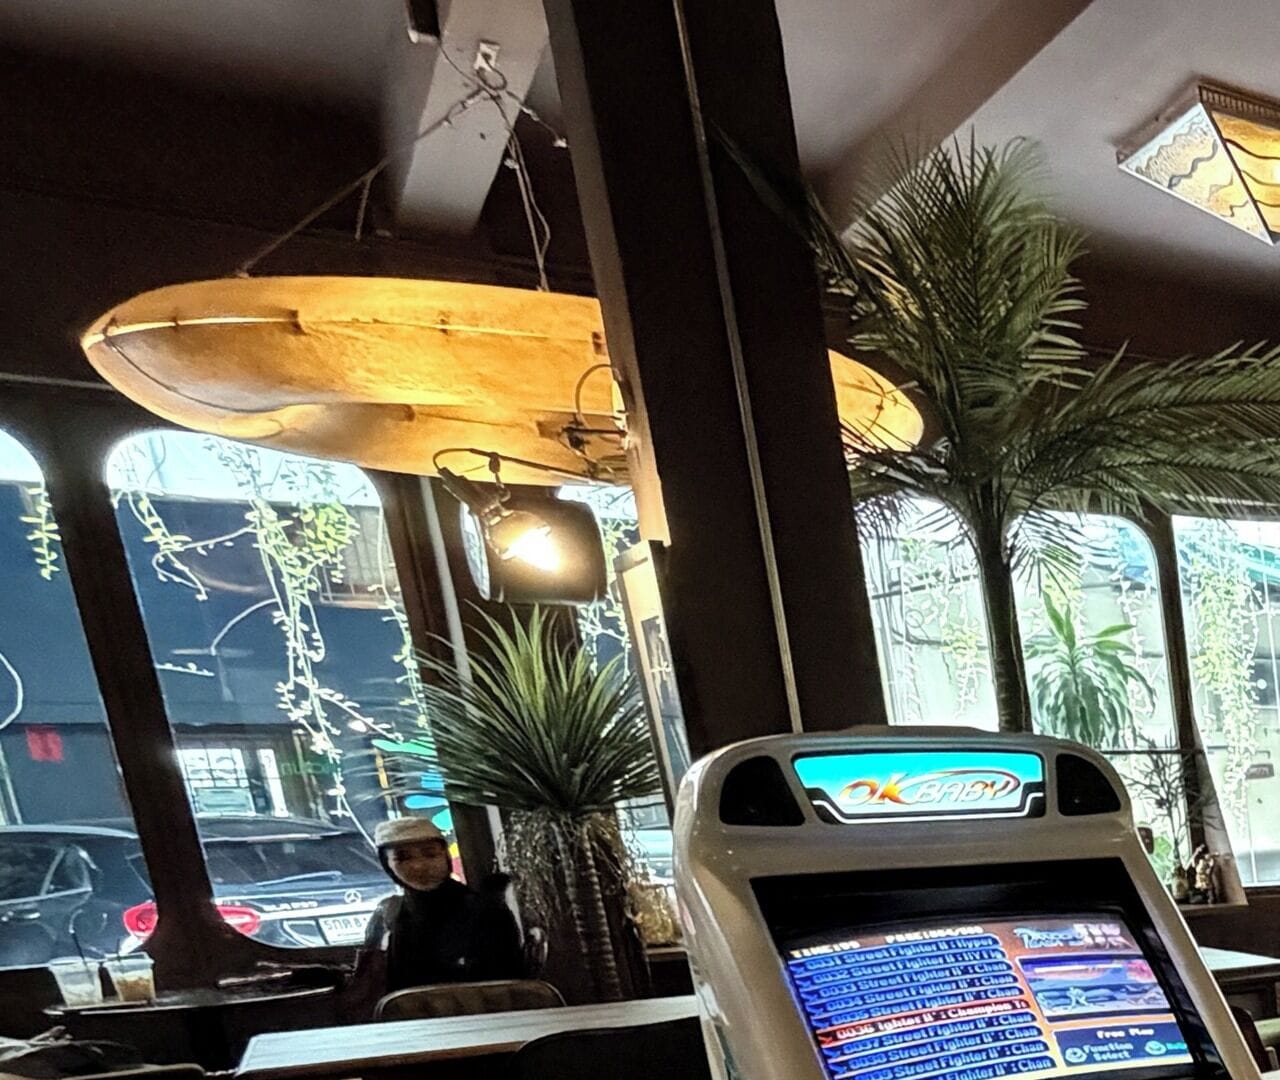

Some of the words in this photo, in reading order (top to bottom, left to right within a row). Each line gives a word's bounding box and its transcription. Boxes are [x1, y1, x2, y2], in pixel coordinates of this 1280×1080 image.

[839, 772, 904, 804] OK
[913, 779, 1011, 804] BABY
[844, 950, 889, 963] Street
[890, 943, 937, 957] Fighter
[851, 962, 896, 976] Street
[897, 955, 945, 970] Fighter
[858, 975, 903, 990] Street
[903, 968, 952, 984] Fighter
[865, 989, 910, 1004] Street
[911, 981, 959, 998] Fighter
[871, 1002, 916, 1017] Street
[917, 994, 964, 1011] Fighter
[883, 1029, 928, 1045] Street
[930, 1020, 976, 1039] Fighter
[889, 1044, 933, 1061] Street
[936, 1035, 982, 1054] Fighter
[895, 1060, 939, 1077] Street
[941, 1050, 988, 1069] Fighter
[1019, 1056, 1051, 1071] Chan
